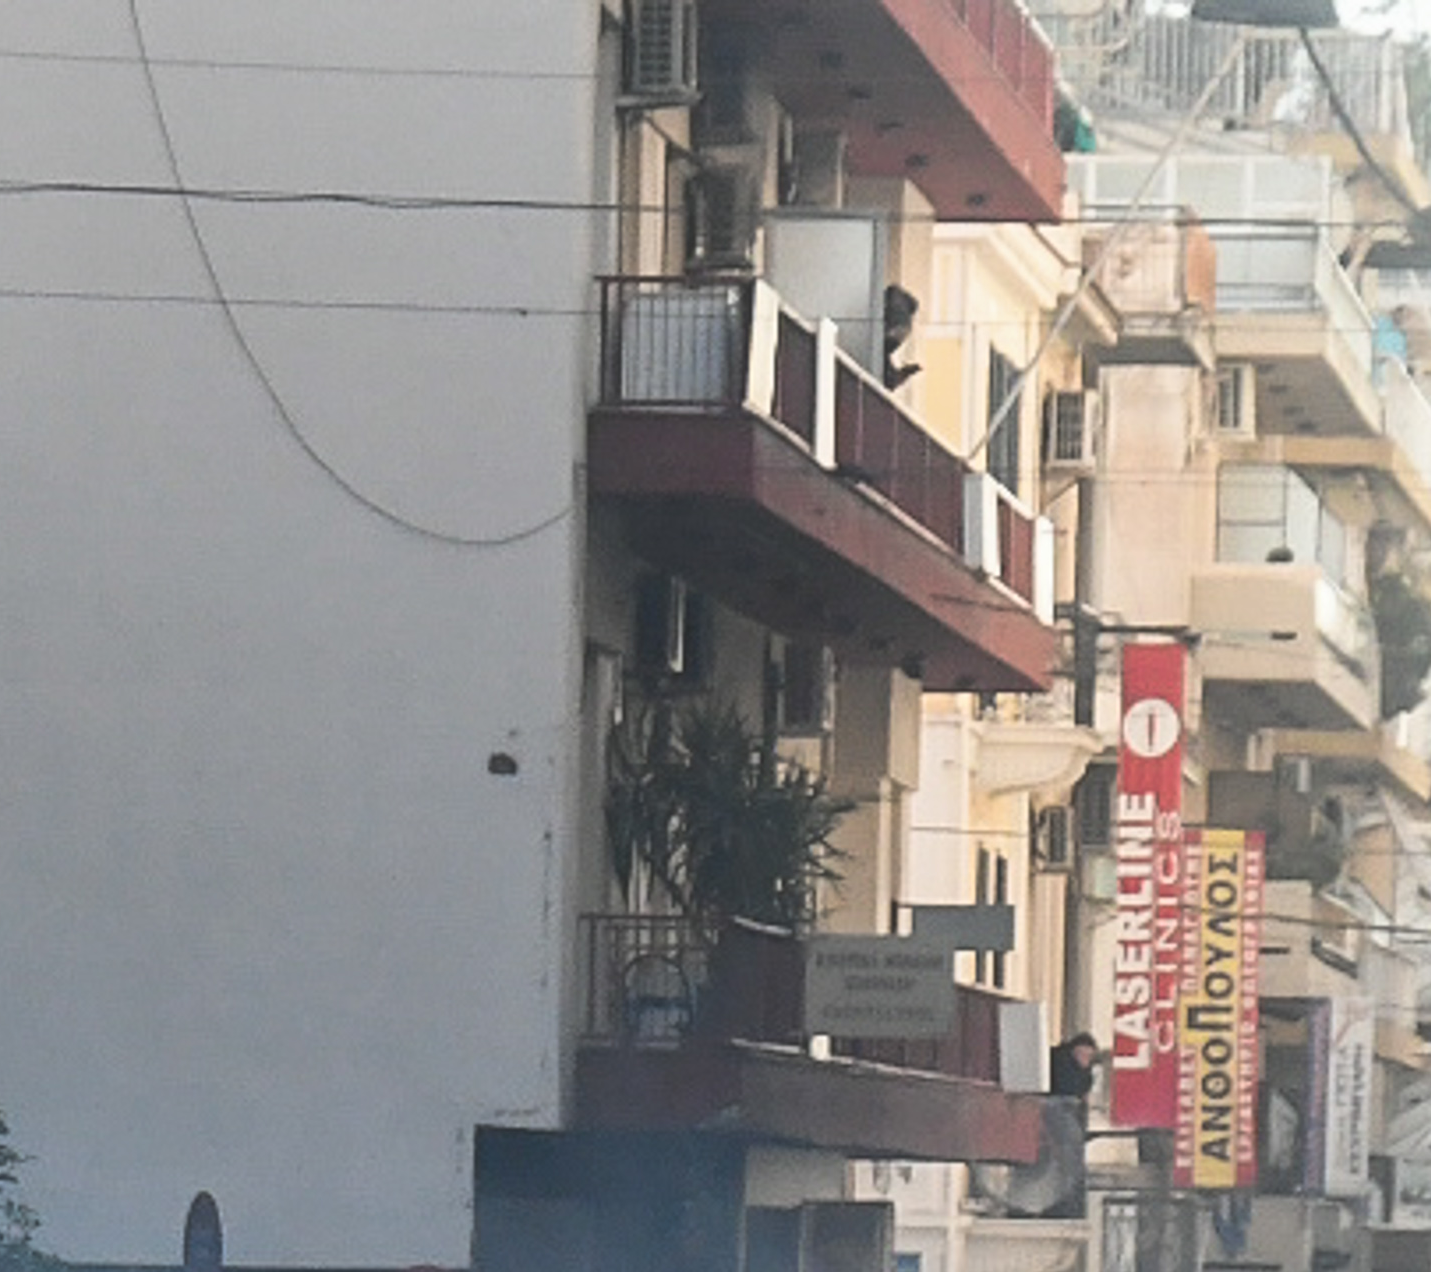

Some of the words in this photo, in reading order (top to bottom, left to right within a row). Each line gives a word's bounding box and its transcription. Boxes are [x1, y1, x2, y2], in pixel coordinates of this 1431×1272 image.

[1111, 792, 1156, 1069] LASERLINE
[1154, 811, 1182, 1053] CLINICS
[1187, 852, 1238, 1163] ΑΝΘΟΠΟΥΛΟΣ
